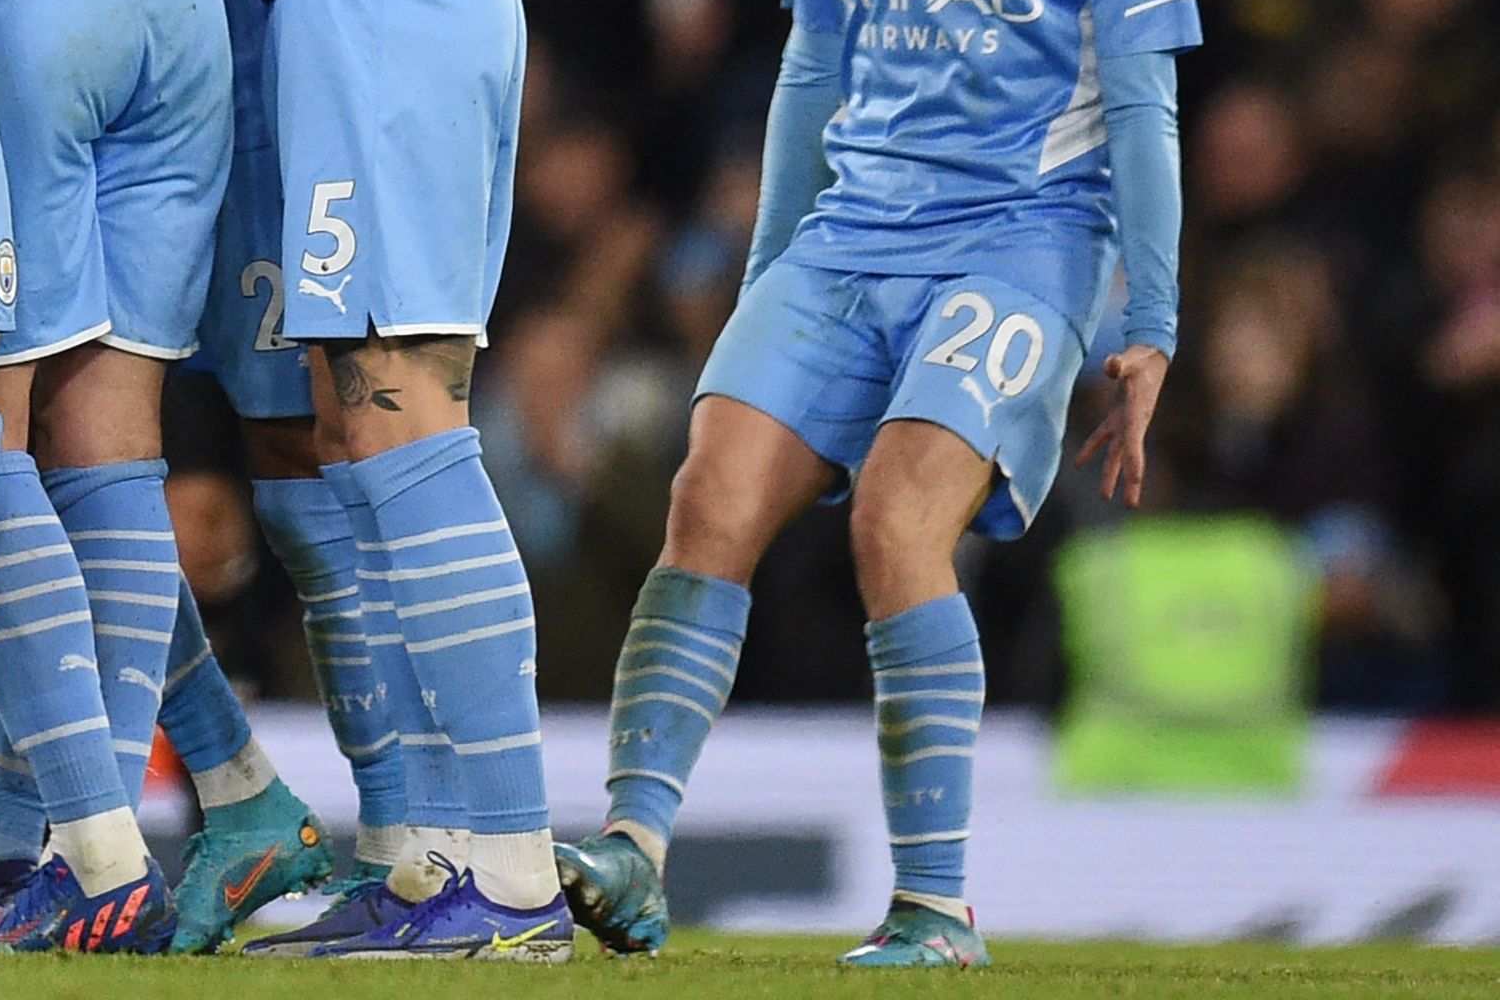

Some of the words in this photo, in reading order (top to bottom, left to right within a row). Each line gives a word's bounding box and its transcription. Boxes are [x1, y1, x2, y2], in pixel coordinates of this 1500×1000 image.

[857, 22, 1000, 55] AIRWAYS
[301, 179, 357, 277] 5
[239, 257, 300, 352] 2
[922, 290, 1045, 398] 20
